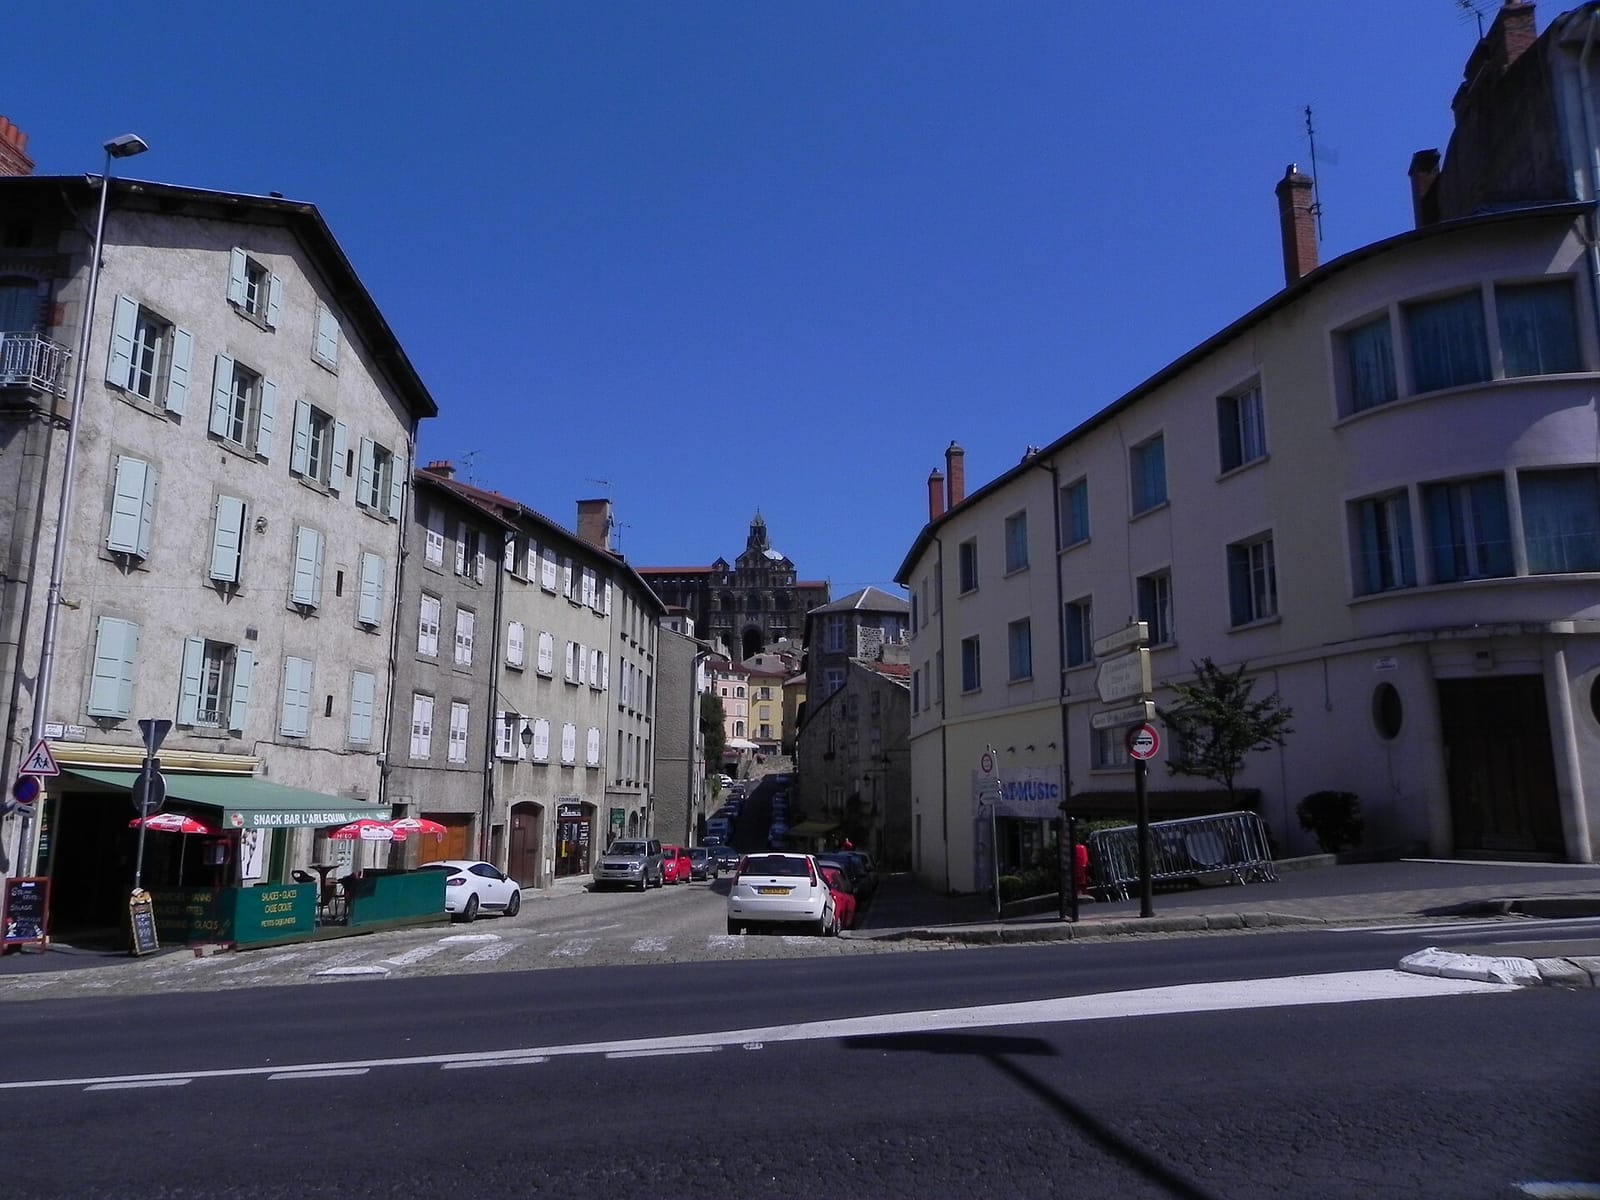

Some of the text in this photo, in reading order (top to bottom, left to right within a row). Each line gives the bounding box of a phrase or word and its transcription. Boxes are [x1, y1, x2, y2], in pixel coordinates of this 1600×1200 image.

[253, 813, 282, 825] SNACK
[284, 813, 300, 825] BAR
[302, 812, 347, 824] L'ARLEQUIN
